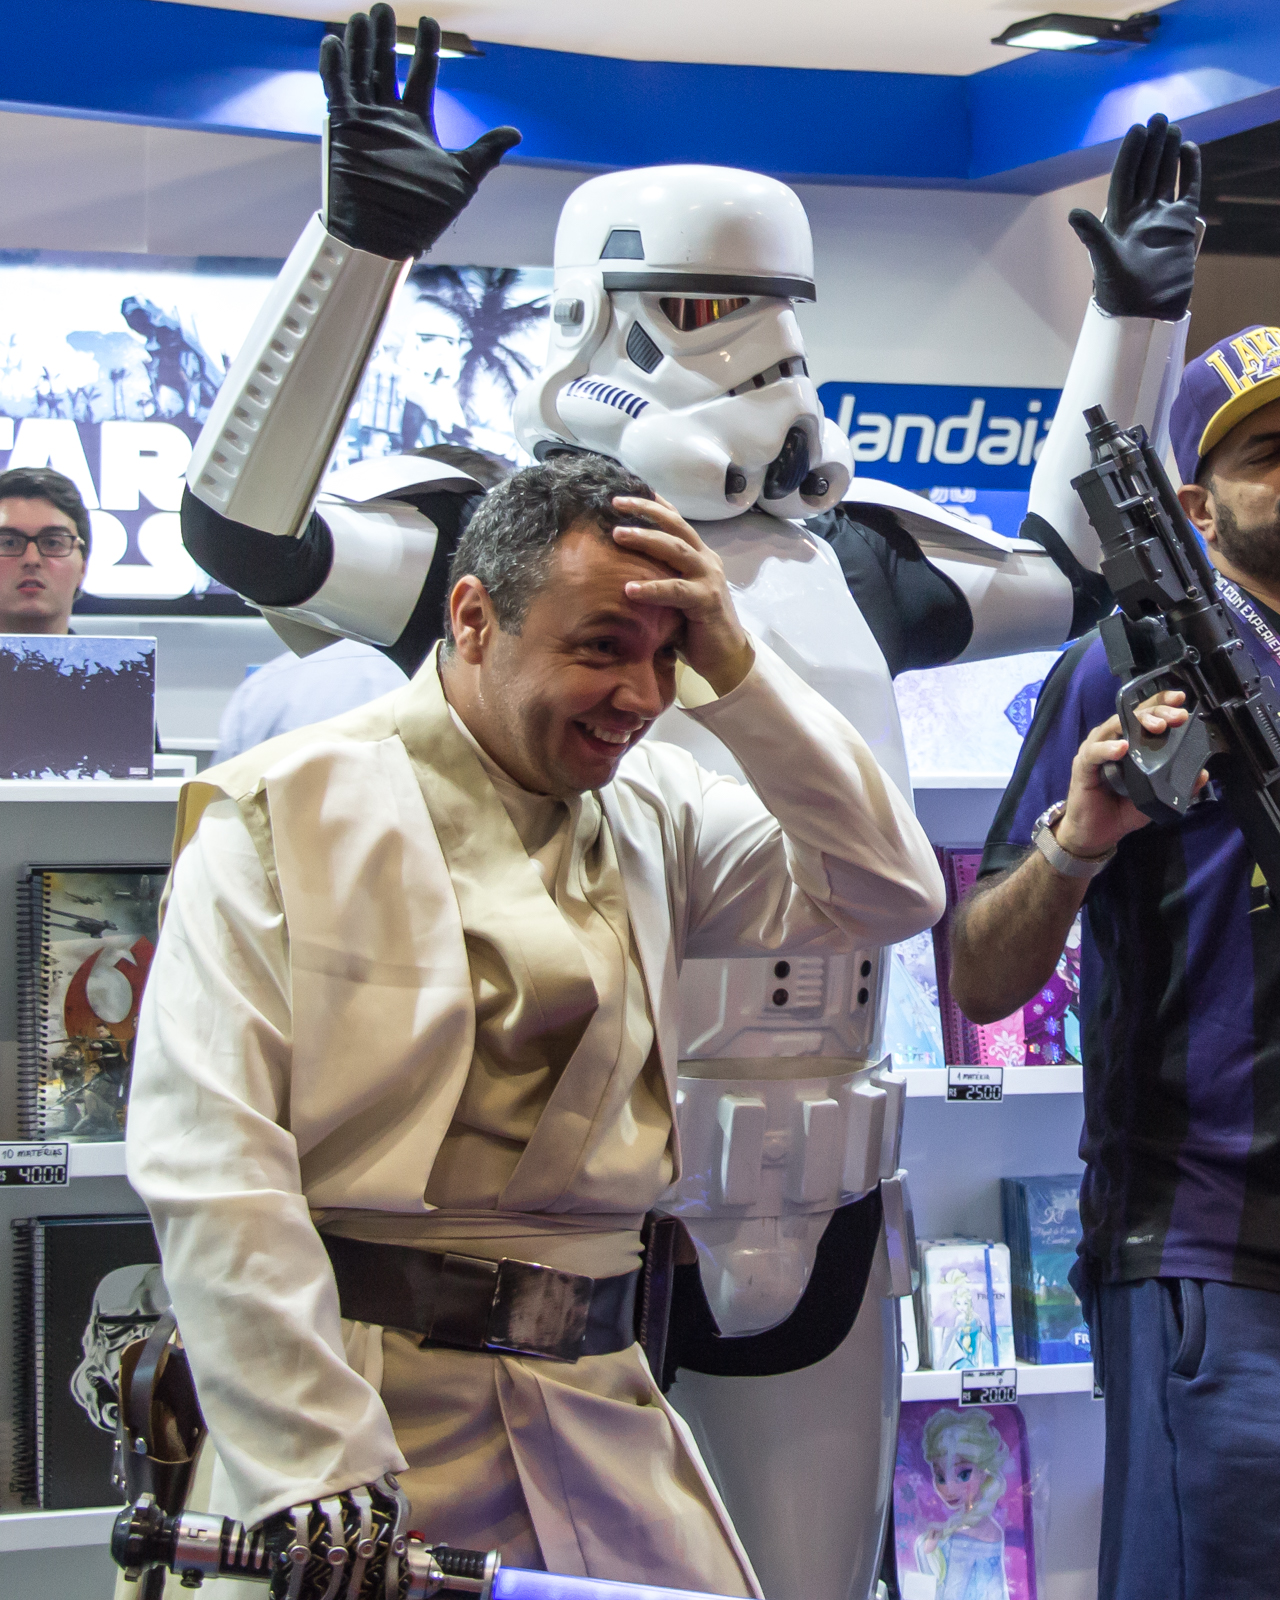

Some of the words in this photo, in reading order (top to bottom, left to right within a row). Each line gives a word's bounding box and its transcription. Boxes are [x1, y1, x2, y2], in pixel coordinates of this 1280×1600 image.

[1222, 586, 1245, 608] CON
[949, 1088, 957, 1098] R$
[2, 1149, 14, 1159] 10
